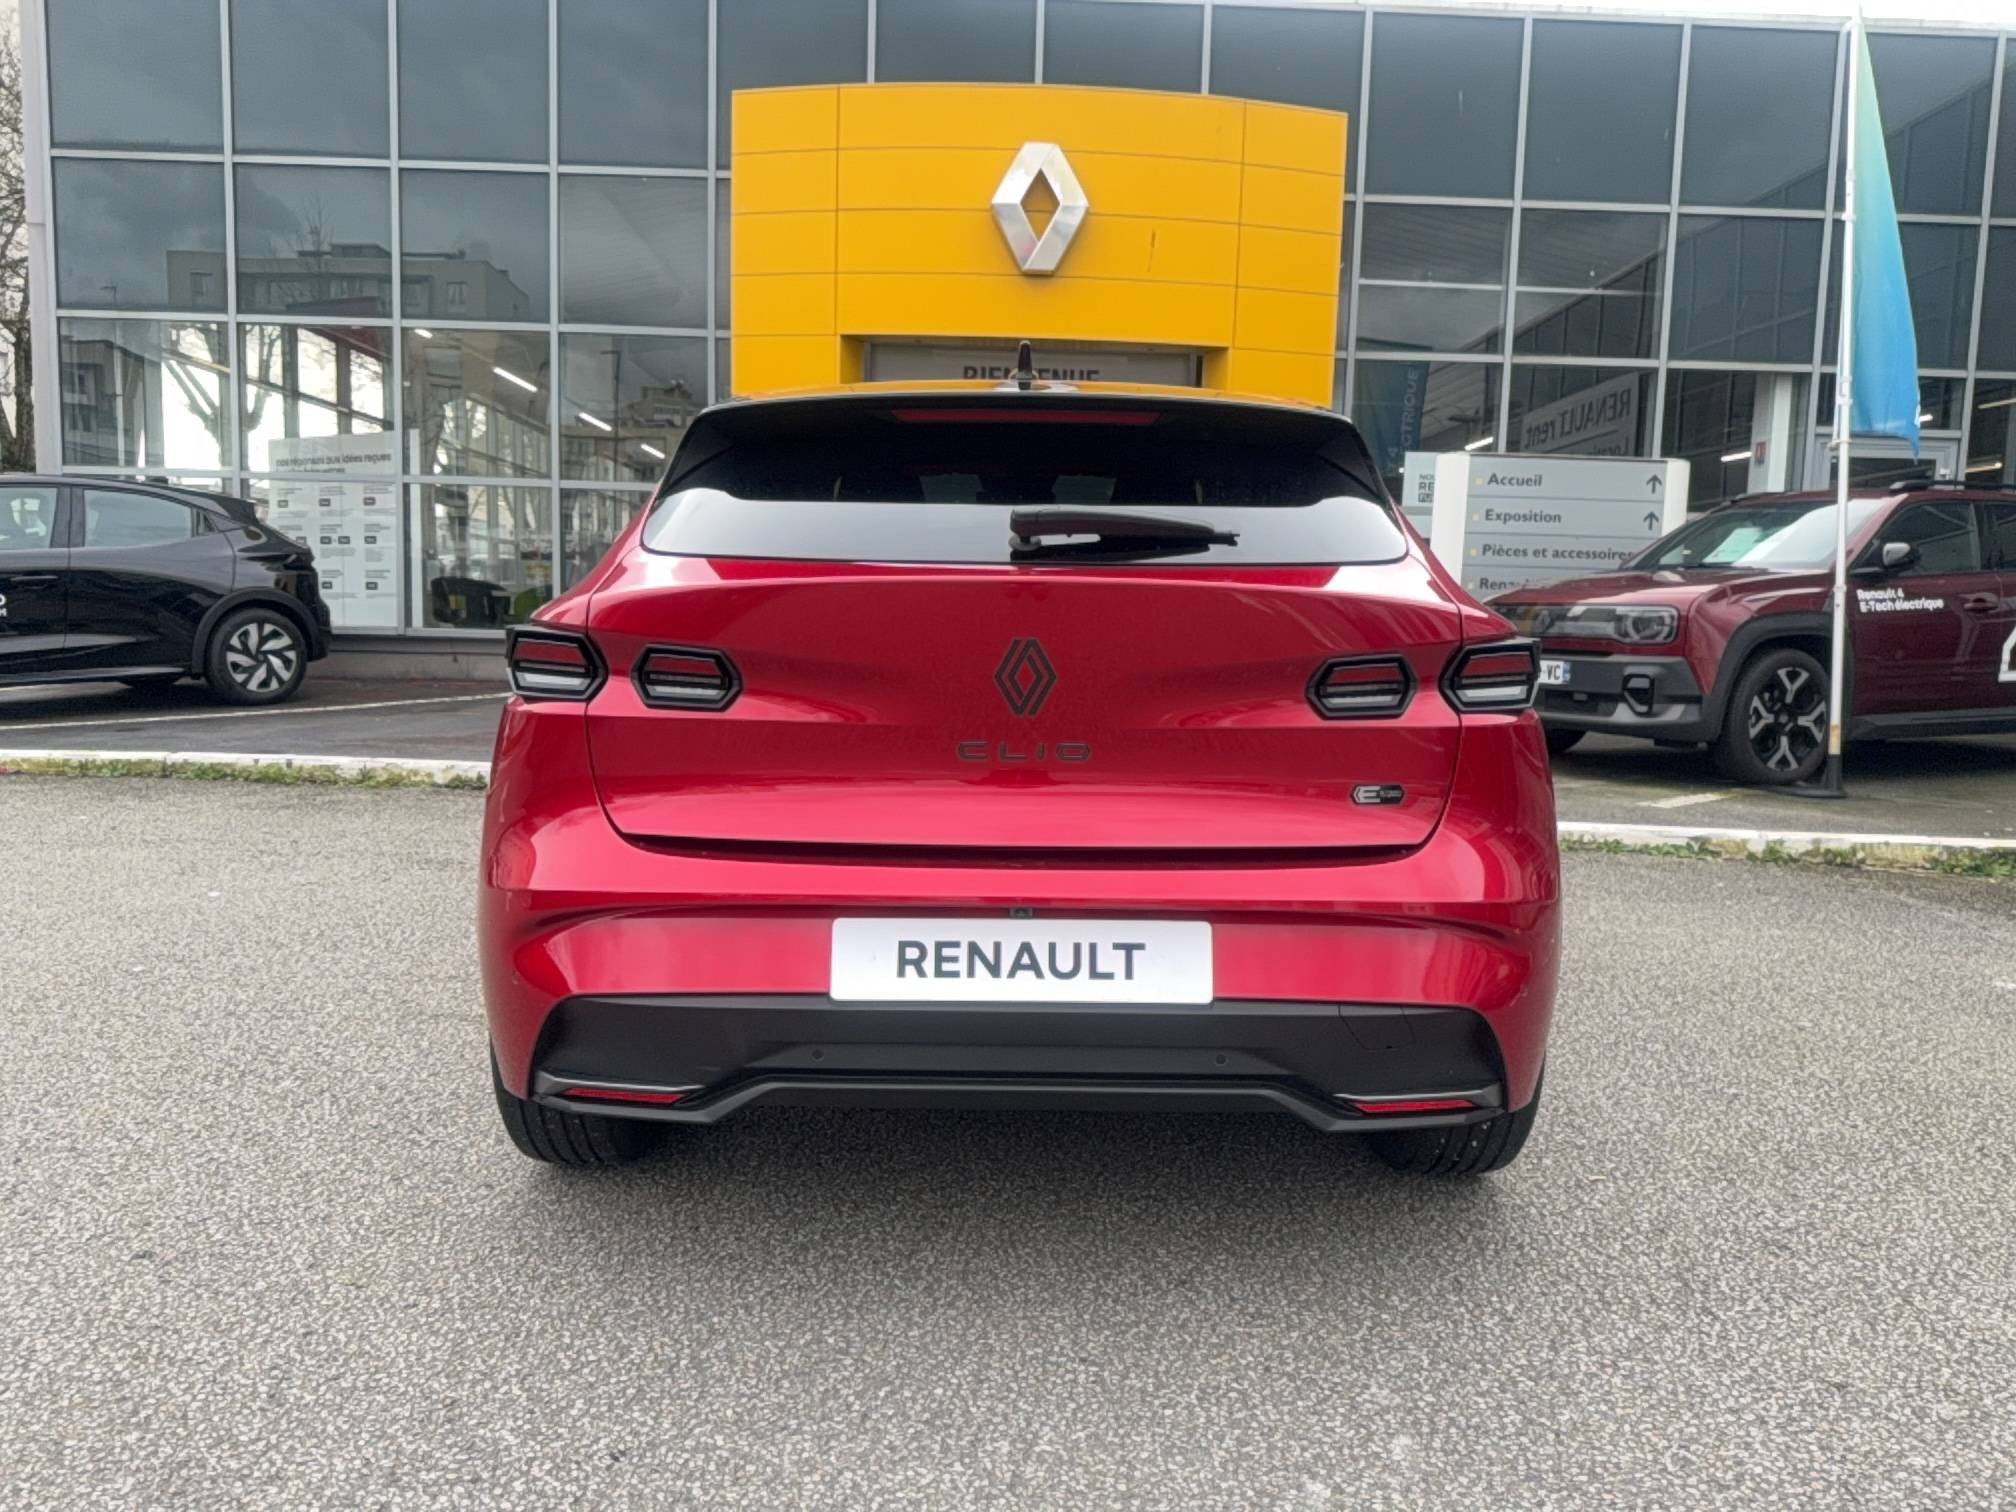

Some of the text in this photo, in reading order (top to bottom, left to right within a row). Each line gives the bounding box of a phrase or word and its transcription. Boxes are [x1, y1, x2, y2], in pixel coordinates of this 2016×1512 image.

[1487, 473, 1543, 487] Accueil
[1485, 508, 1562, 525] Exposition
[1482, 543, 1529, 557] Pièces
[1533, 547, 1547, 558] et
[1856, 588, 1896, 600] Renault
[958, 740, 1091, 761] CLIO
[896, 939, 1147, 981] RENAULT
